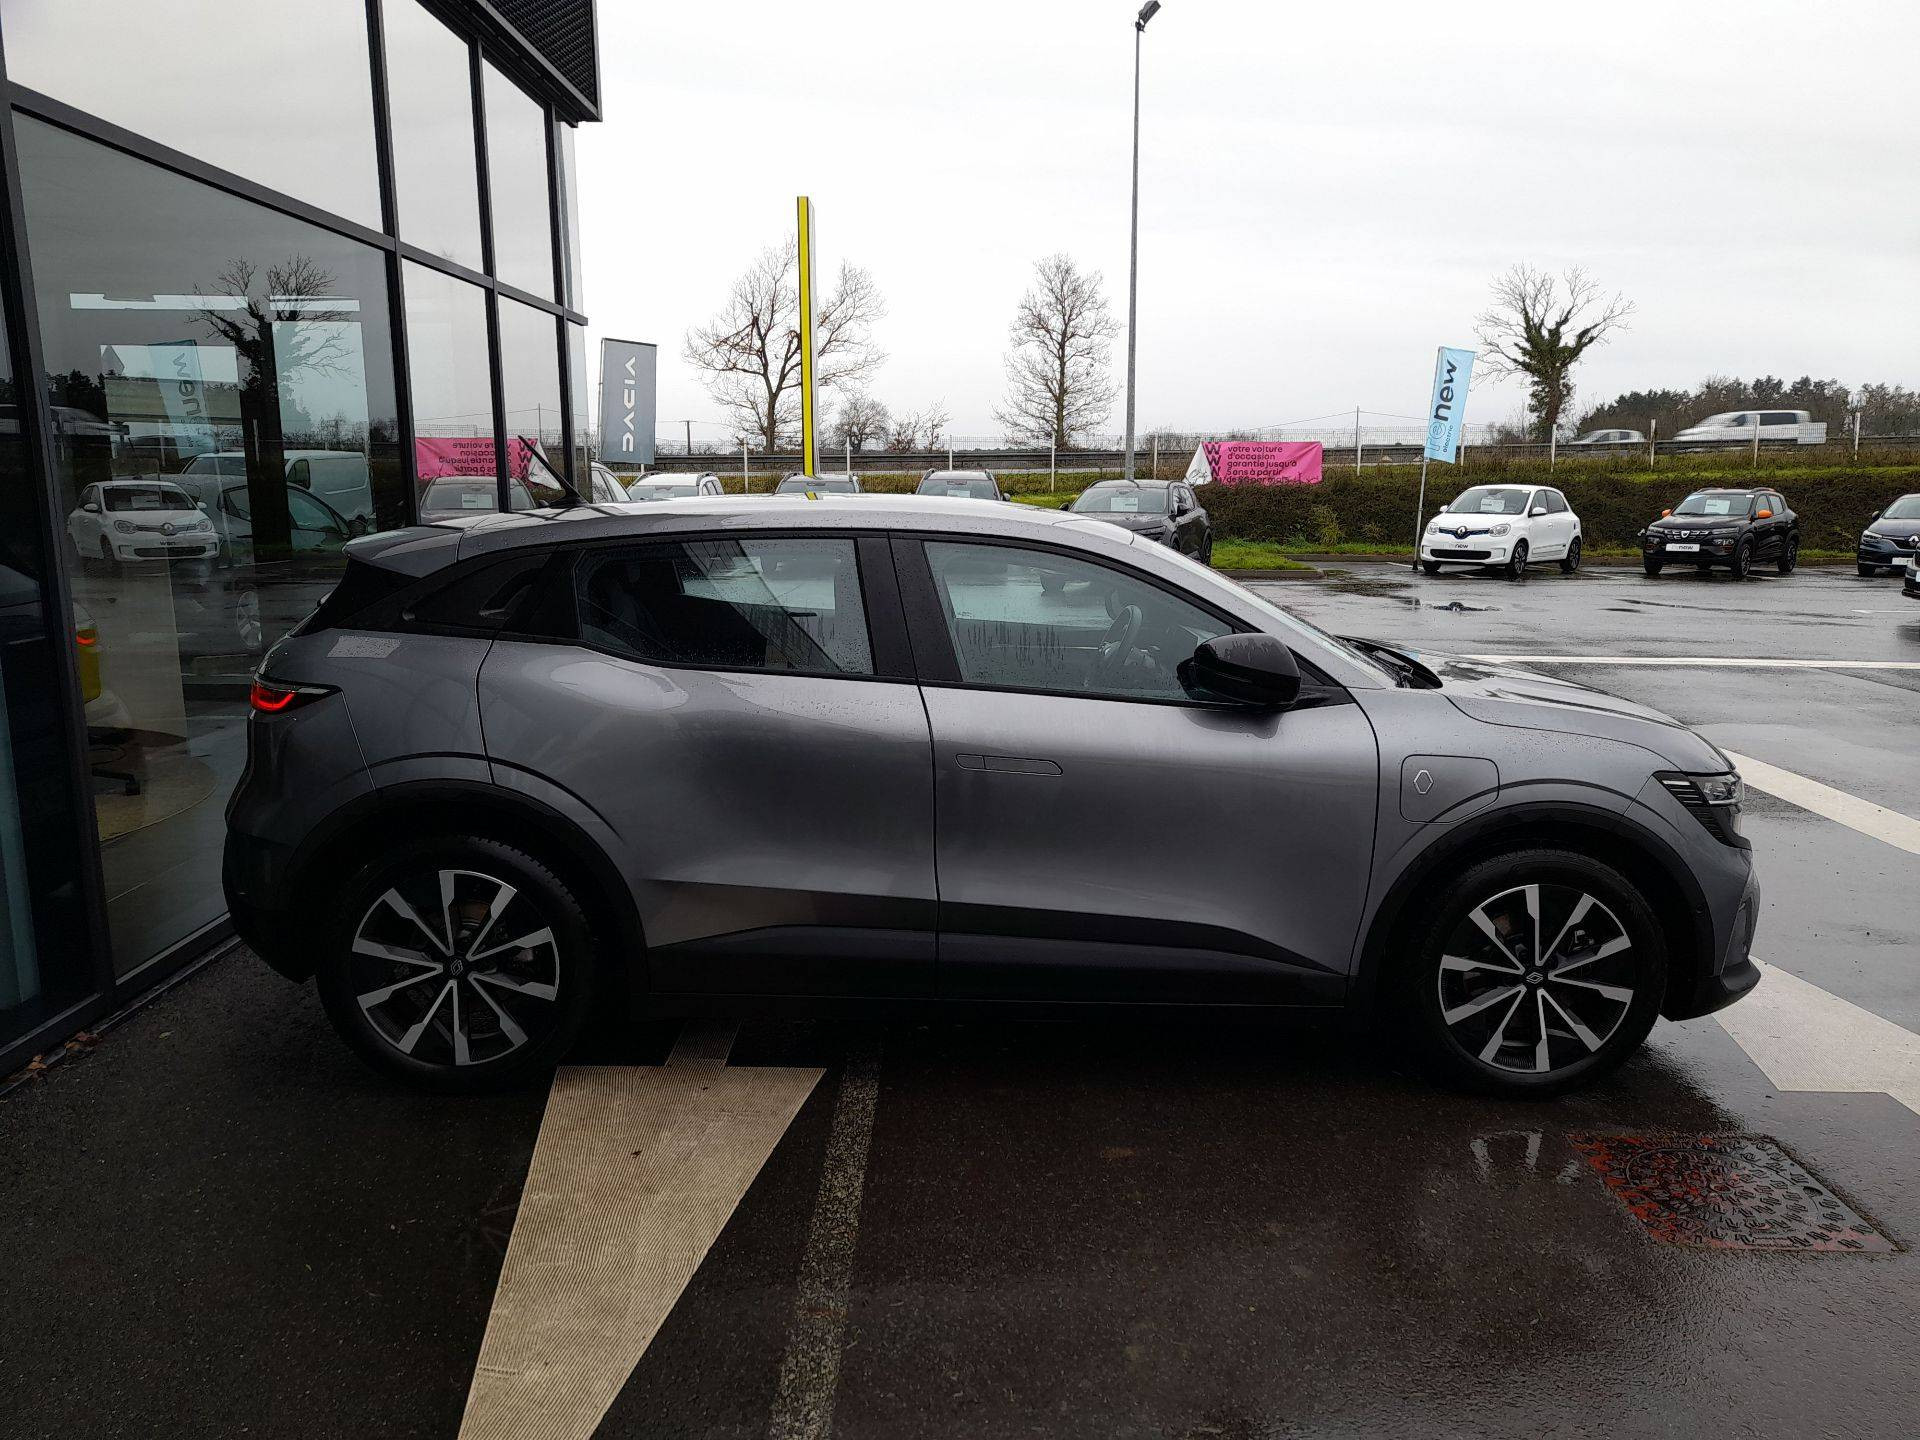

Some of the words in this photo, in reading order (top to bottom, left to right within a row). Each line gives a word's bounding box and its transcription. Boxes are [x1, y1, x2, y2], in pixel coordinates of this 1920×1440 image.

[622, 355, 636, 452] DACIA
[1227, 445, 1251, 453] votre
[1252, 444, 1283, 453] voiture
[1227, 452, 1276, 460] d'occasion
[1227, 459, 1265, 469] garantie
[1256, 468, 1282, 478] partir
